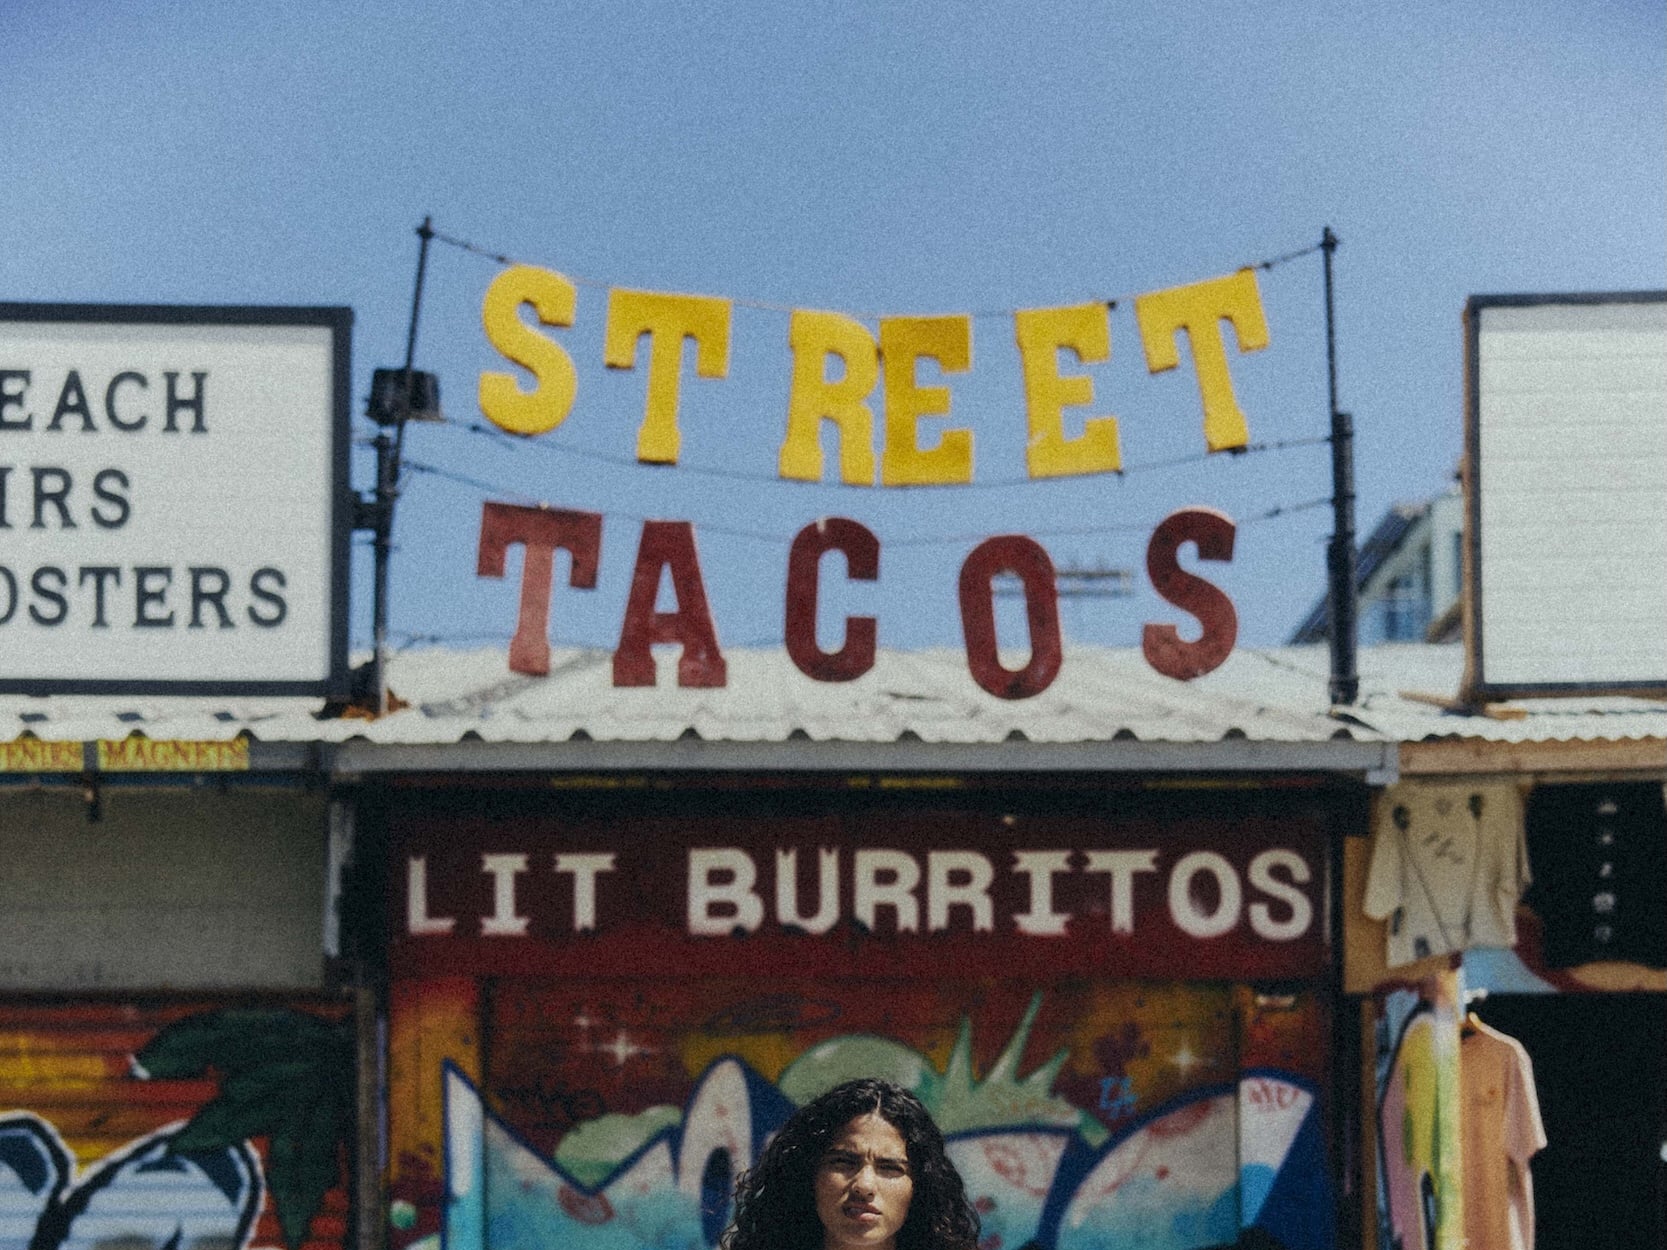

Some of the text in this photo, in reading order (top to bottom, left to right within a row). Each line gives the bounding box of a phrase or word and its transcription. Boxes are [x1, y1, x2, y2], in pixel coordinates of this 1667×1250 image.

[0, 369, 209, 434] EACH
[478, 263, 1269, 487] STREET
[476, 500, 1238, 700] TACOS
[407, 847, 1314, 942] LIT BURRITOS
